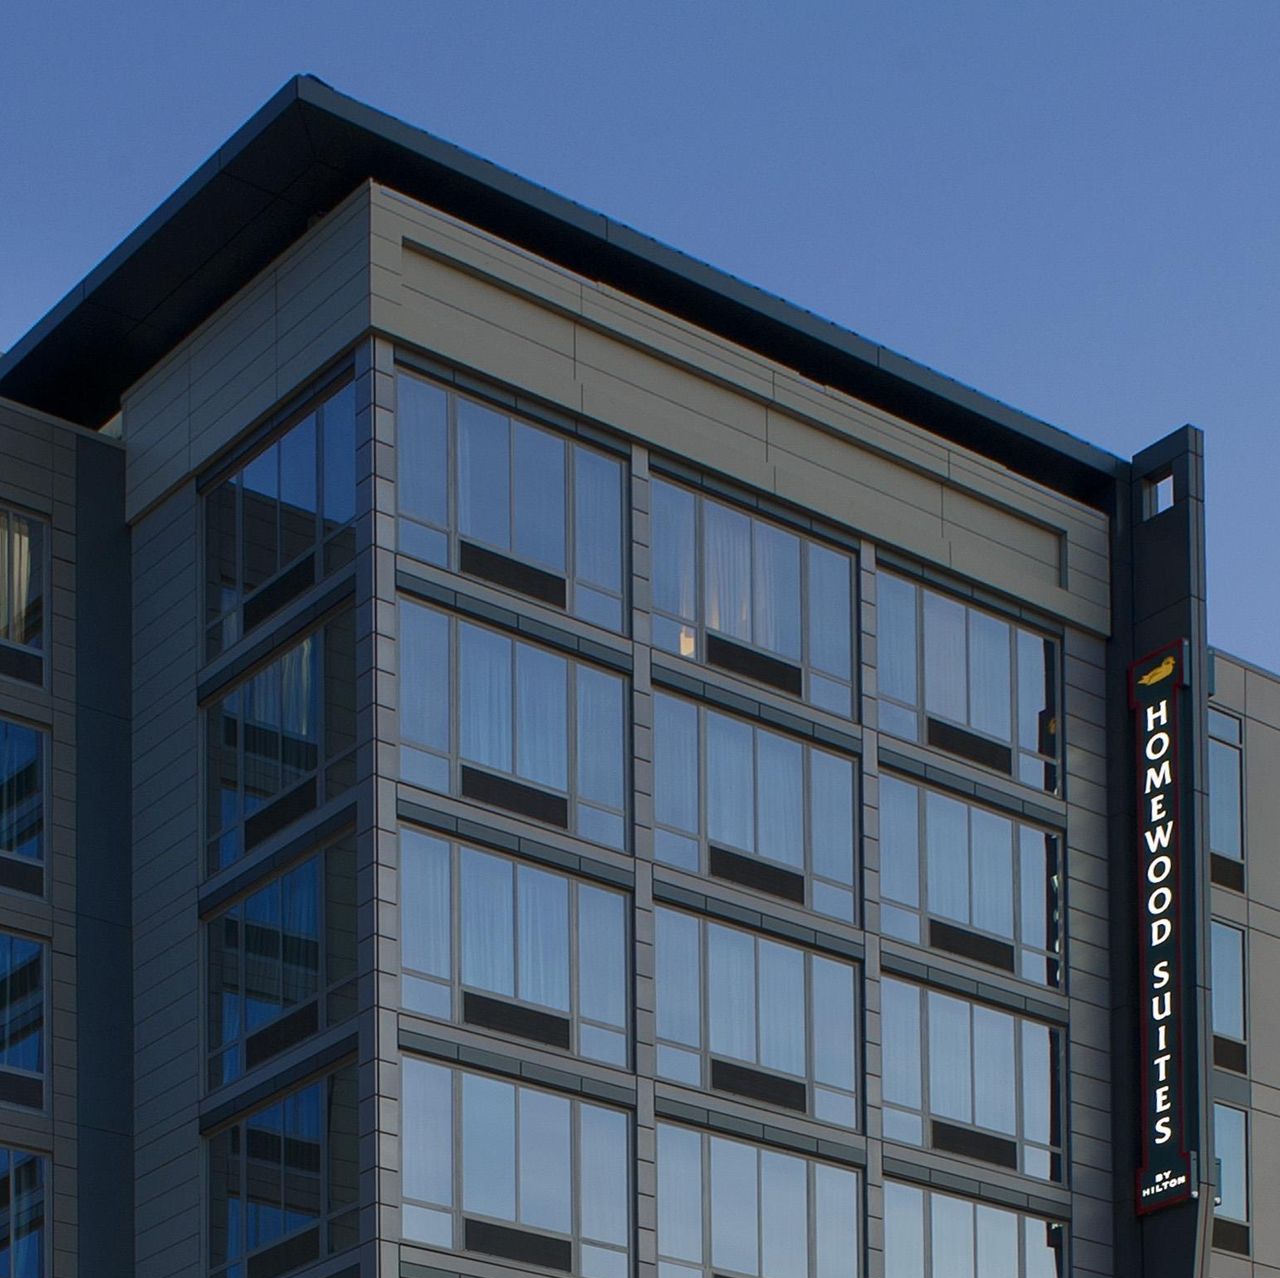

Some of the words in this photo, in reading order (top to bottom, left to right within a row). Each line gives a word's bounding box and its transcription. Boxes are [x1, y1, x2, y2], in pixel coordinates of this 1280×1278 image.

[1144, 699, 1174, 947] HOMEWOOD
[1151, 961, 1172, 1144] SUITES
[1142, 1175, 1186, 1197] HILTON
[1155, 1170, 1172, 1183] BY
